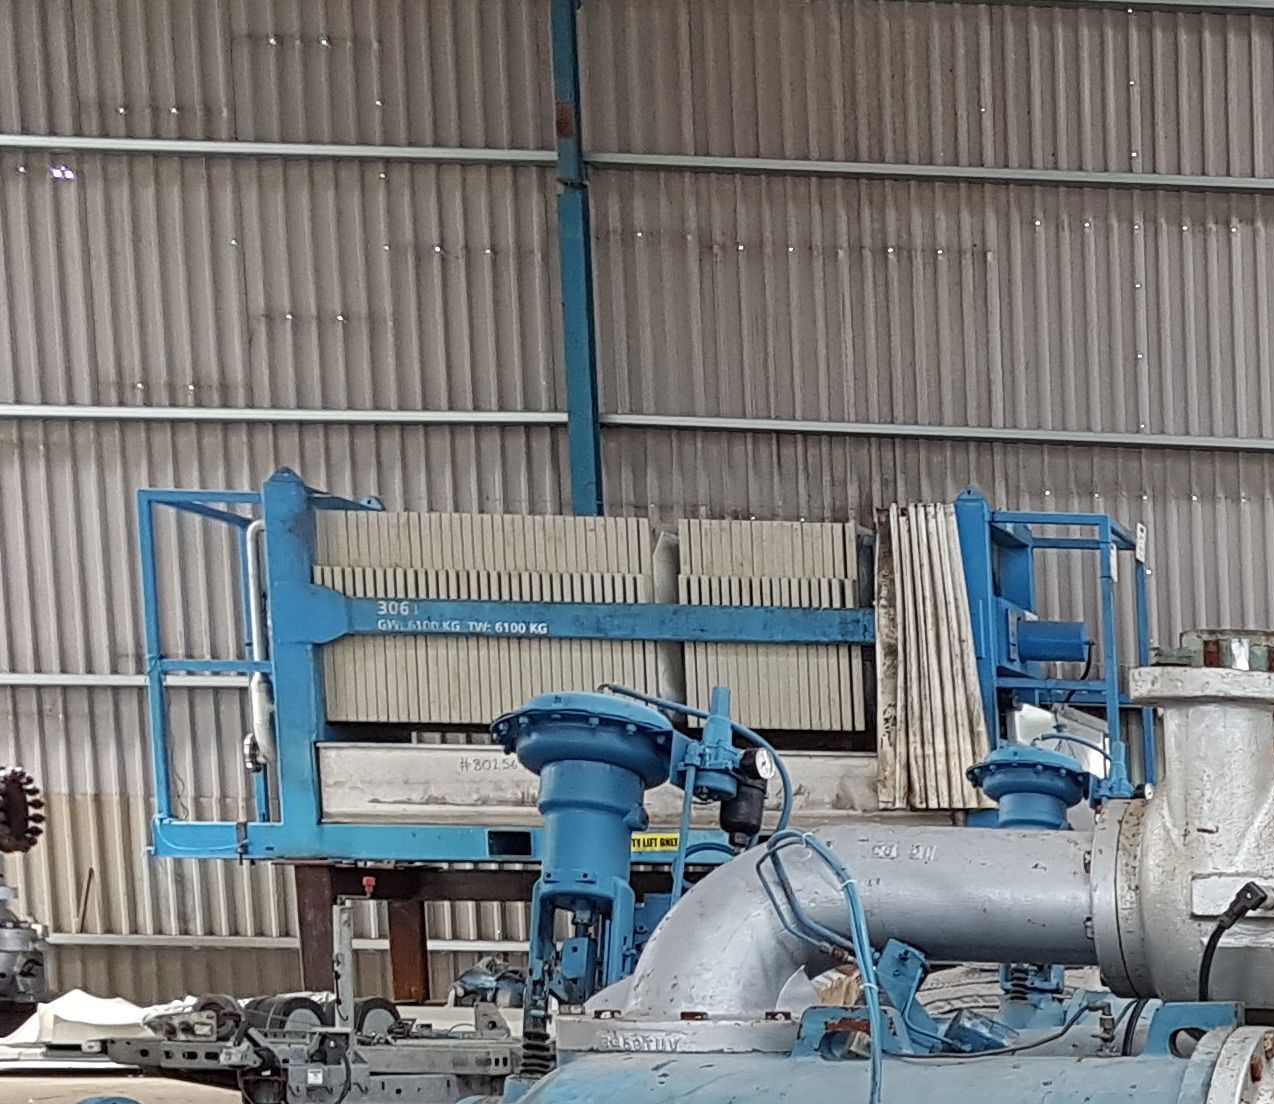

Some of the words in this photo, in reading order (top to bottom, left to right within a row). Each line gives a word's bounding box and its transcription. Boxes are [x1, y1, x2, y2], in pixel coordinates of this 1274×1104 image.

[442, 620, 461, 632] KG
[467, 621, 492, 633] TW:
[495, 621, 526, 634] 6100
[529, 622, 548, 635] KG
[643, 837, 657, 848] LIFT
[660, 837, 679, 847] ONLY
